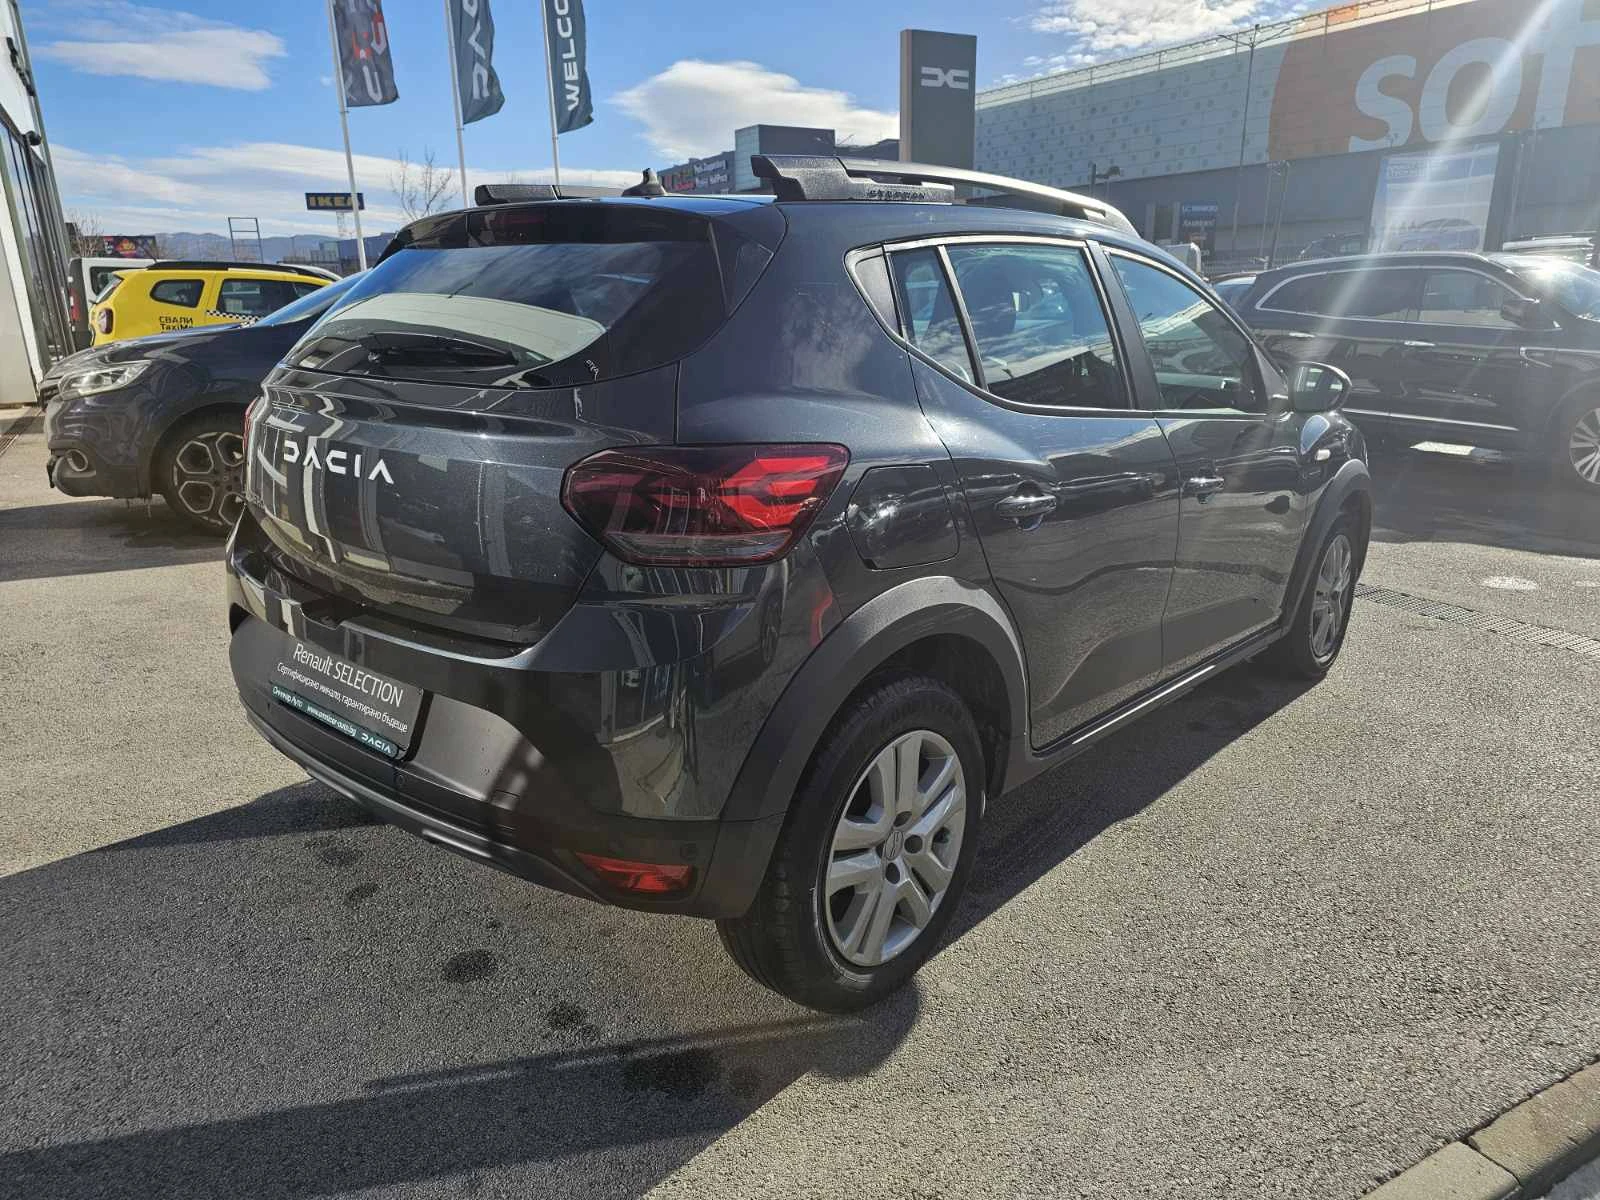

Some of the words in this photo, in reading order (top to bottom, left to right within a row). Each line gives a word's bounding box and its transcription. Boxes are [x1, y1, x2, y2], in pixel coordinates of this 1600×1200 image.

[158, 316, 193, 324] СВАЛИ
[283, 440, 395, 485] DACIA
[292, 643, 333, 676] Renault
[333, 661, 404, 708] SELECTION
[341, 695, 381, 720] гарантирано
[381, 711, 408, 733] бъдеще
[360, 732, 392, 753] DACIA
